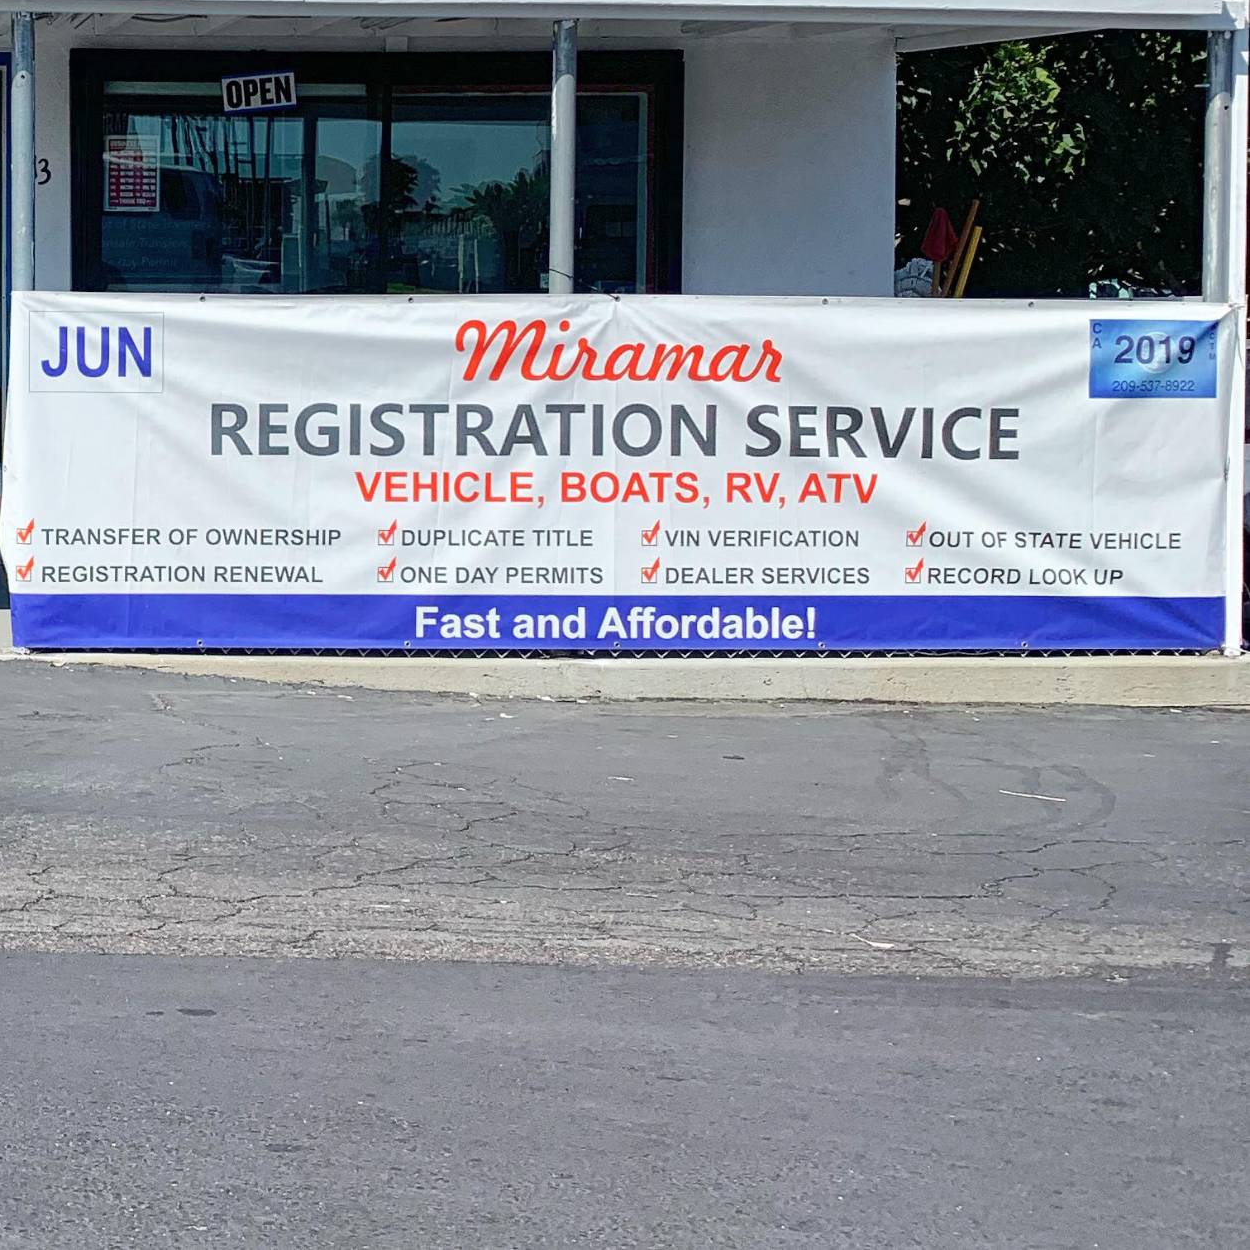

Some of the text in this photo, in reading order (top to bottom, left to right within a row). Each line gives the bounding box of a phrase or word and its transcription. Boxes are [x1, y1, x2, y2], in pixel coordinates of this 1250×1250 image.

[226, 75, 291, 109] OPEN
[34, 154, 51, 185] 3
[41, 326, 151, 377] JUN
[455, 319, 782, 382] Miramar
[1113, 335, 1196, 364] 2019
[1112, 380, 1196, 391] 209-537-8922
[211, 403, 1020, 460] REGISTRATION SERVICE
[355, 471, 879, 509] VEHICLE, BOATS, RV, ATV
[41, 528, 342, 546] TRANSFER OF OWNERSHIP
[401, 529, 593, 547] DUPLICATE TITLE
[665, 530, 859, 547] VIN VERIFICATION
[929, 531, 1182, 549] OUT OF STATE VEHICLE
[41, 565, 323, 583] REGISTRATION RENEWAL
[400, 566, 603, 584] ONE DAY PERMITS
[665, 567, 870, 585] DEALER SERVICES
[927, 567, 1124, 585] RECORD LOOK UP
[415, 606, 816, 640] Fast and Affordable!
